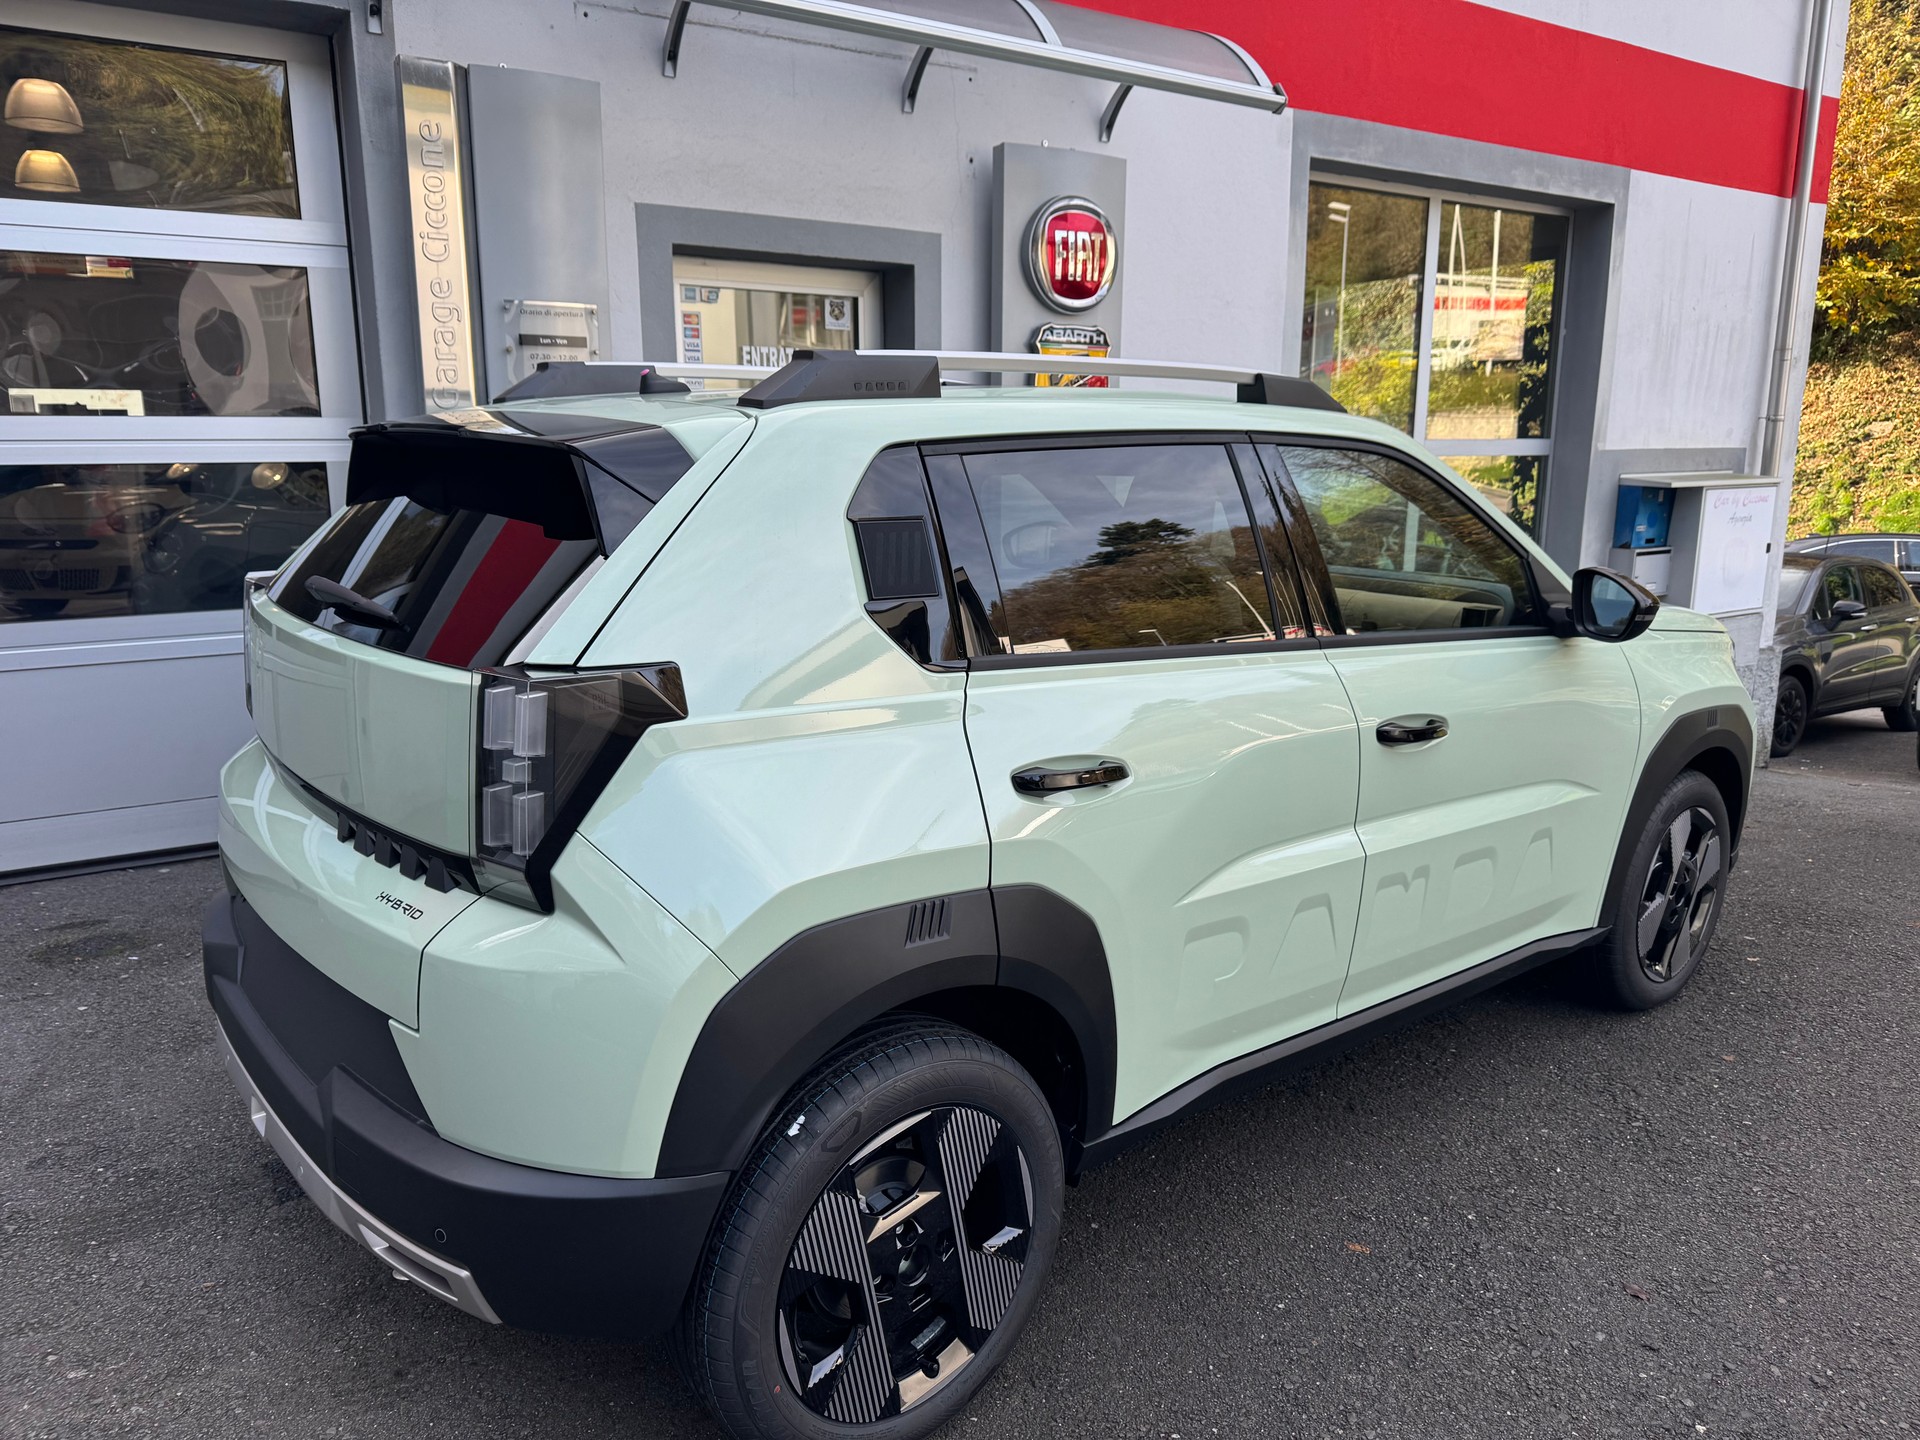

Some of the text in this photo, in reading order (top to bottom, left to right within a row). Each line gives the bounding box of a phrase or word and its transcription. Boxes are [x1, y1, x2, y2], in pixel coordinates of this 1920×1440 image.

[1054, 228, 1104, 282] FIAT
[418, 118, 463, 410] Garage Ciccone
[519, 308, 543, 316] Orario
[553, 310, 584, 318] apertura
[539, 337, 552, 345] Lun
[1041, 328, 1105, 344] ABARTH
[686, 341, 700, 349] VISA
[529, 353, 551, 361] 07.30
[686, 354, 700, 362] VISA
[742, 345, 798, 368] ENTRAT
[375, 891, 424, 920] HYBRID
